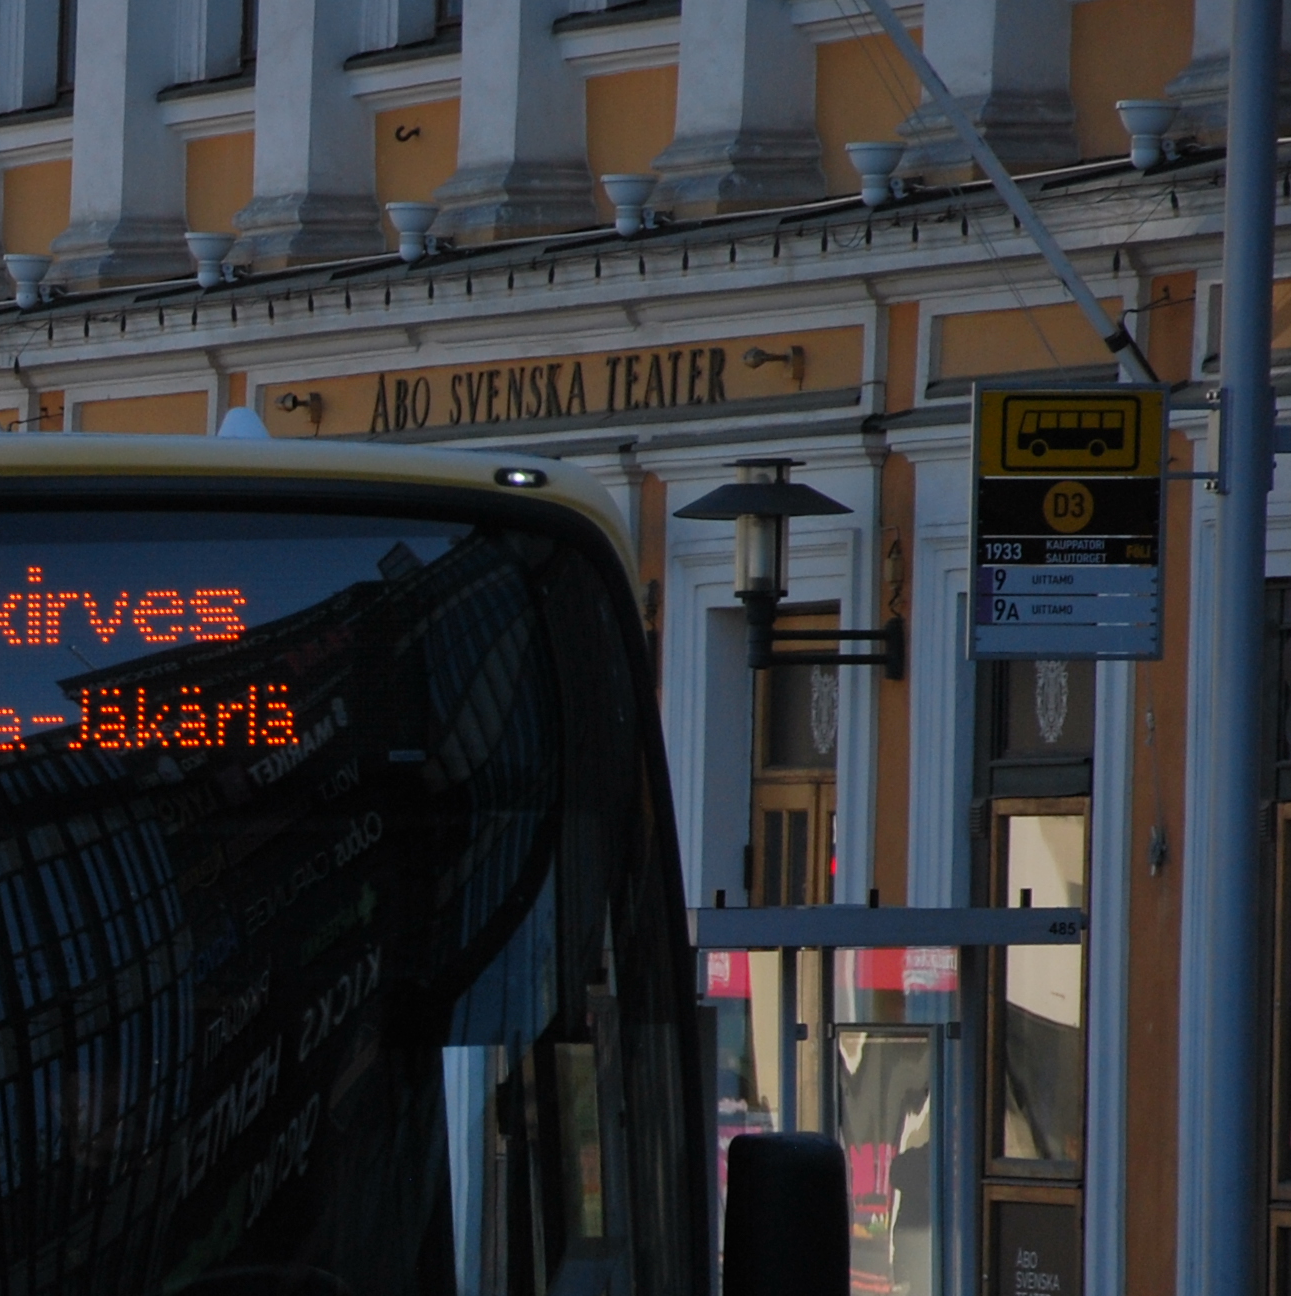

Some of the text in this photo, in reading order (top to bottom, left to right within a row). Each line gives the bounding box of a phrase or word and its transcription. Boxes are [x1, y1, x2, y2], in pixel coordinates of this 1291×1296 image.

[371, 347, 725, 434] ÅBO SVENSKA TEATER
[1053, 491, 1086, 518] D3
[984, 543, 1023, 560] 1933
[1045, 539, 1106, 551] KAUPPATORI
[1045, 552, 1107, 564] SALUTORGET
[994, 569, 1074, 591] 9 UITTAMO
[994, 599, 1073, 621] 9A UITTAMO
[1049, 922, 1076, 935] 485
[1015, 1247, 1039, 1269] ÅBO
[1015, 1271, 1061, 1291] SVENSKA
